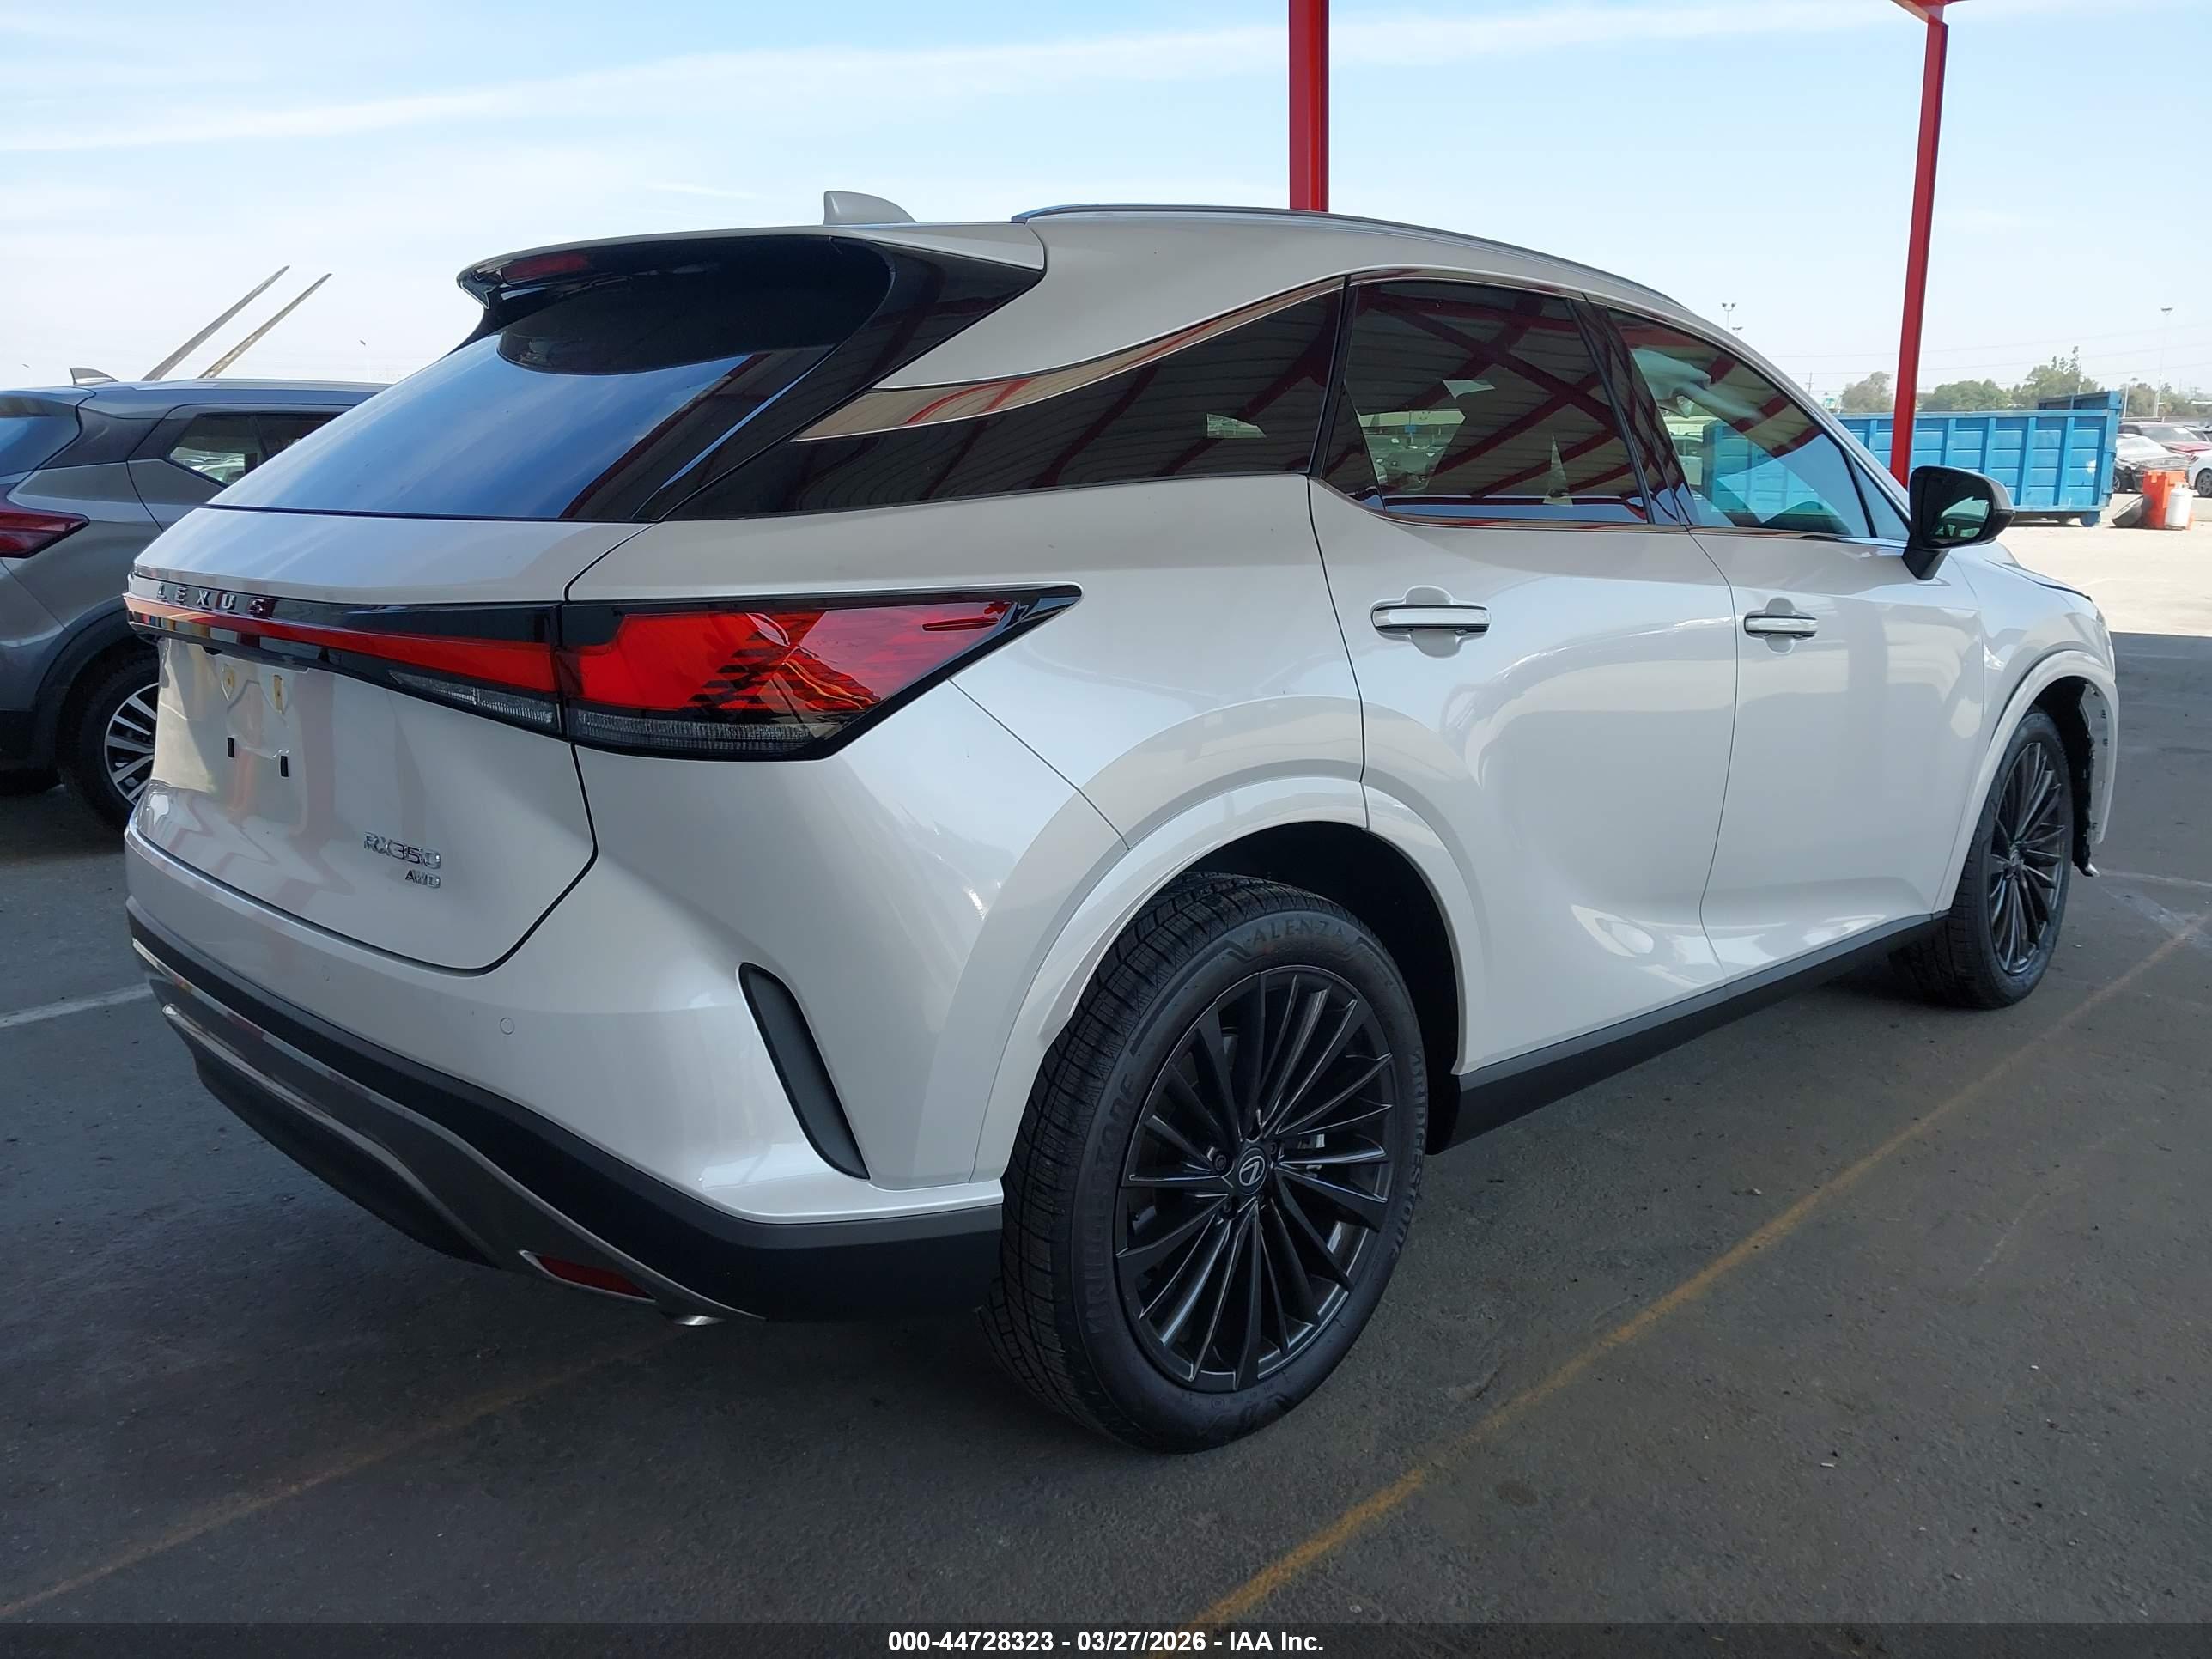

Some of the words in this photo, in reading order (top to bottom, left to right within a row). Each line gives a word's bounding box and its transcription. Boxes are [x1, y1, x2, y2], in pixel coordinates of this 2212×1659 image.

[157, 582, 265, 614] LEXUS
[405, 870, 441, 889] AWD
[1251, 919, 1346, 945] ALENZA
[1084, 1073, 1135, 1334] BRIDGSTONE
